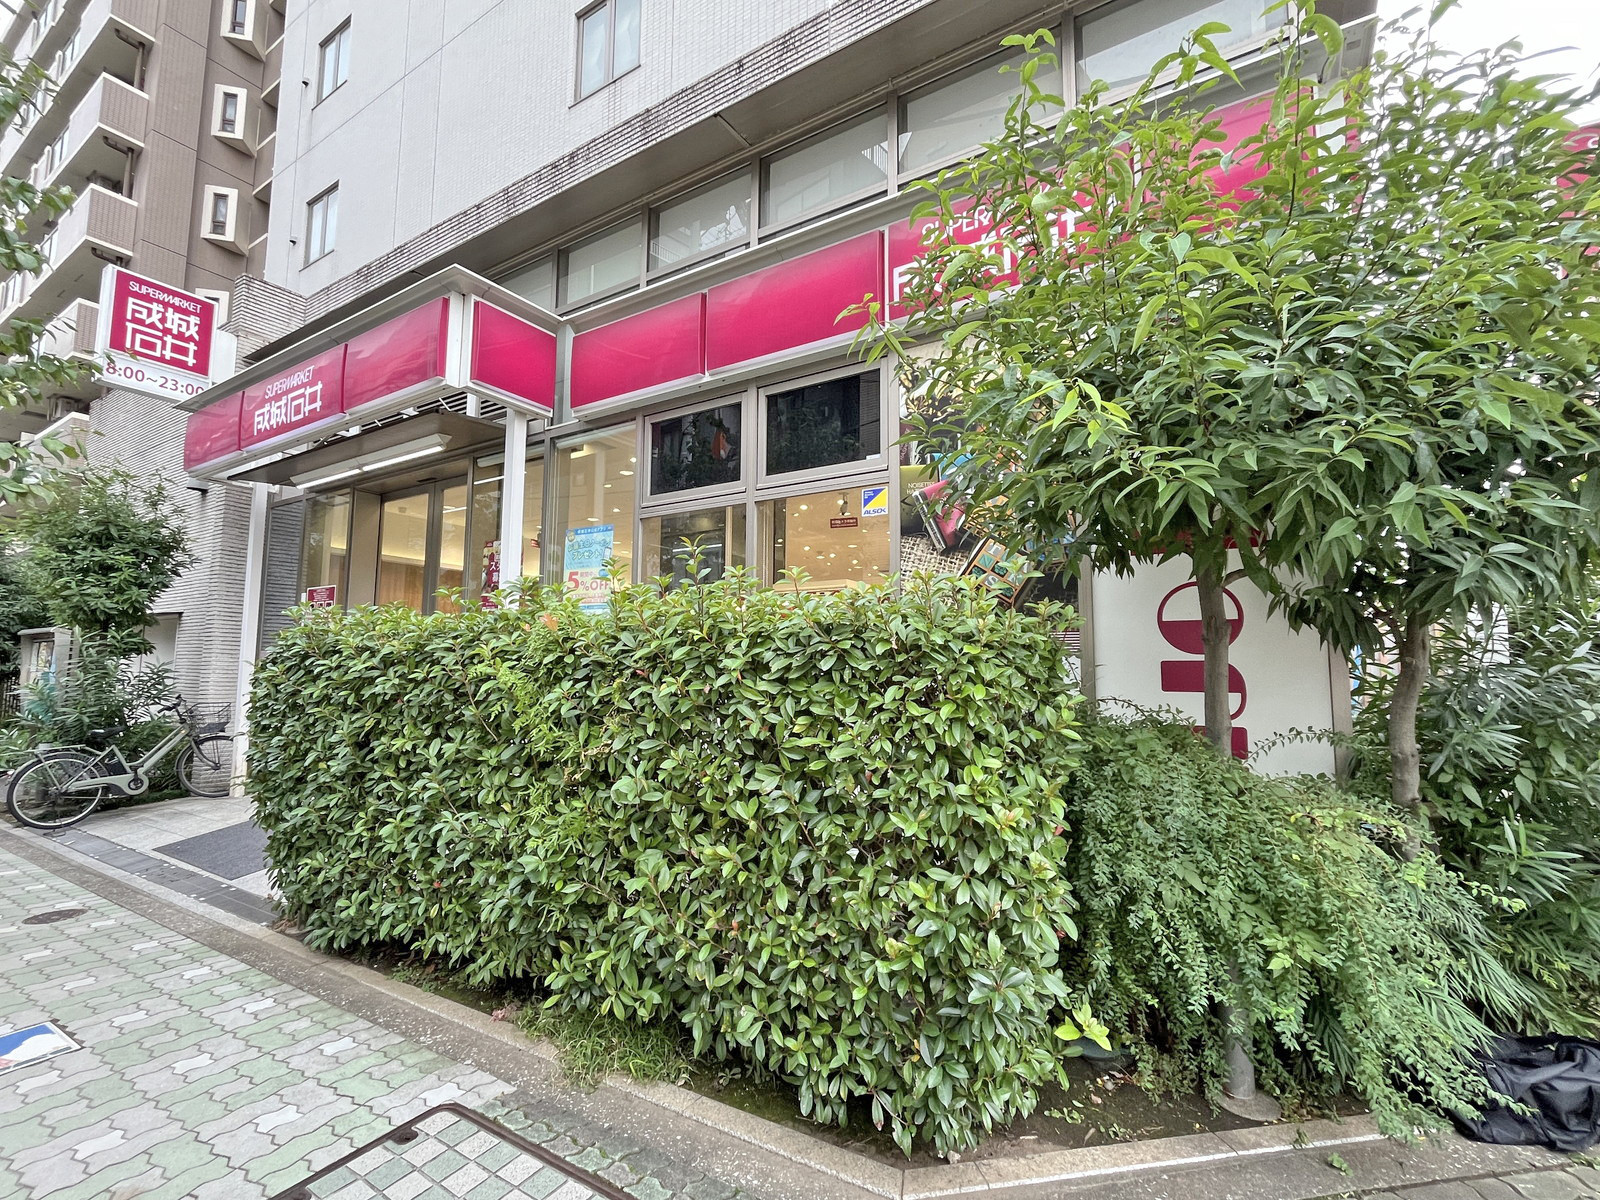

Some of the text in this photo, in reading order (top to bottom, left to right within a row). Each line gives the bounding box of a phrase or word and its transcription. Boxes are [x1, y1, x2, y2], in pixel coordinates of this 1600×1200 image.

[128, 280, 202, 314] SUPERMARKET
[126, 296, 201, 342] 成城
[125, 321, 198, 367] 石井
[264, 364, 315, 400] SUPERMARKET
[253, 380, 323, 436] 成城石井
[863, 507, 887, 515] ALSOK
